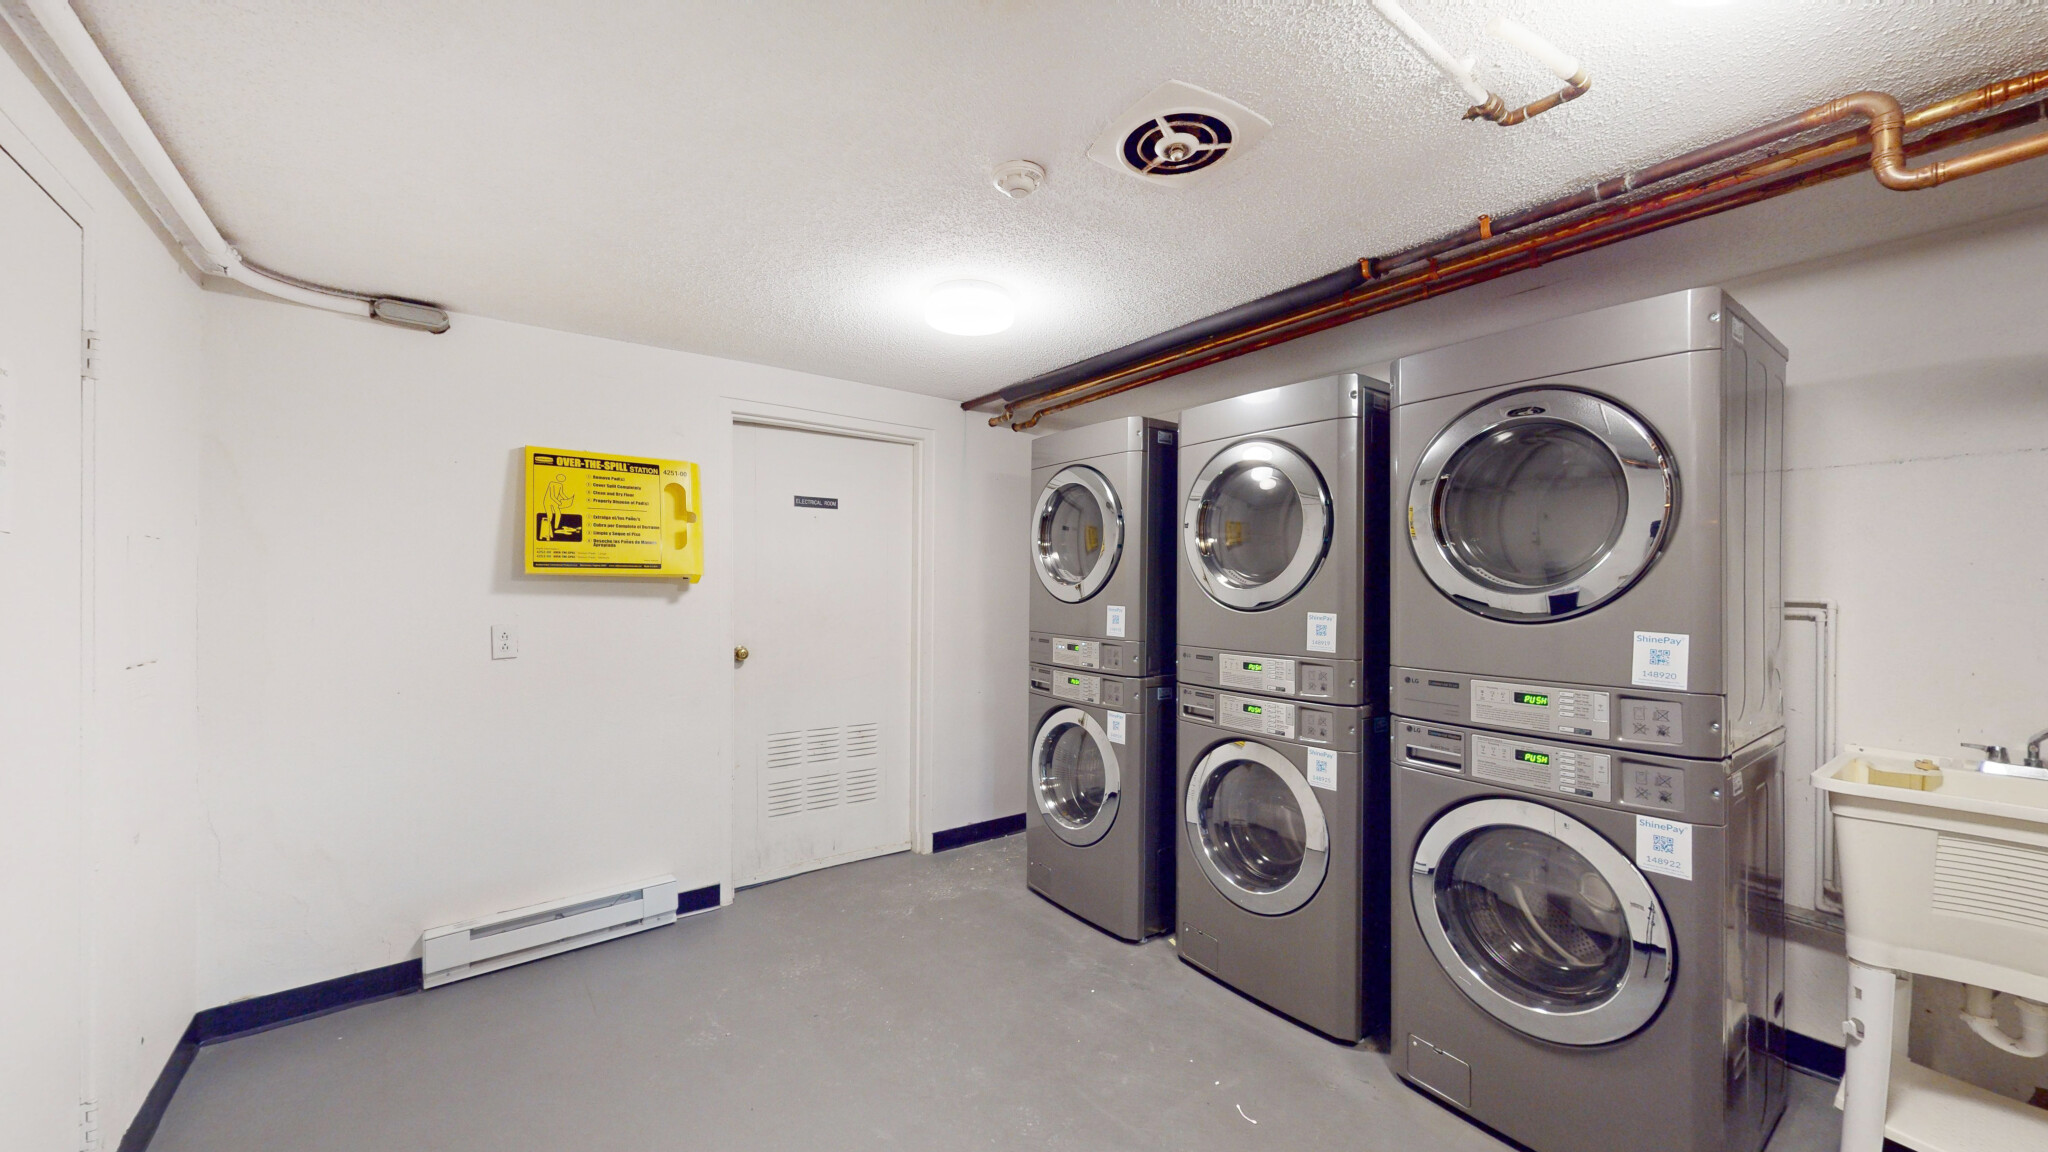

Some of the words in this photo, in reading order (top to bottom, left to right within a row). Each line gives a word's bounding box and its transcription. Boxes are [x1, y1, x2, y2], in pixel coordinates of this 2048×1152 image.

[556, 456, 628, 472] OVER-THE-SPILL
[629, 466, 659, 475] STATION
[795, 498, 822, 506] ELECTRICAL
[1636, 634, 1682, 647] ShinePay
[1642, 669, 1677, 681] 148920
[1523, 694, 1547, 705] PUSH
[1524, 753, 1548, 764] PUSH
[1639, 817, 1685, 836] ShinePay
[1645, 854, 1681, 869] 148922
